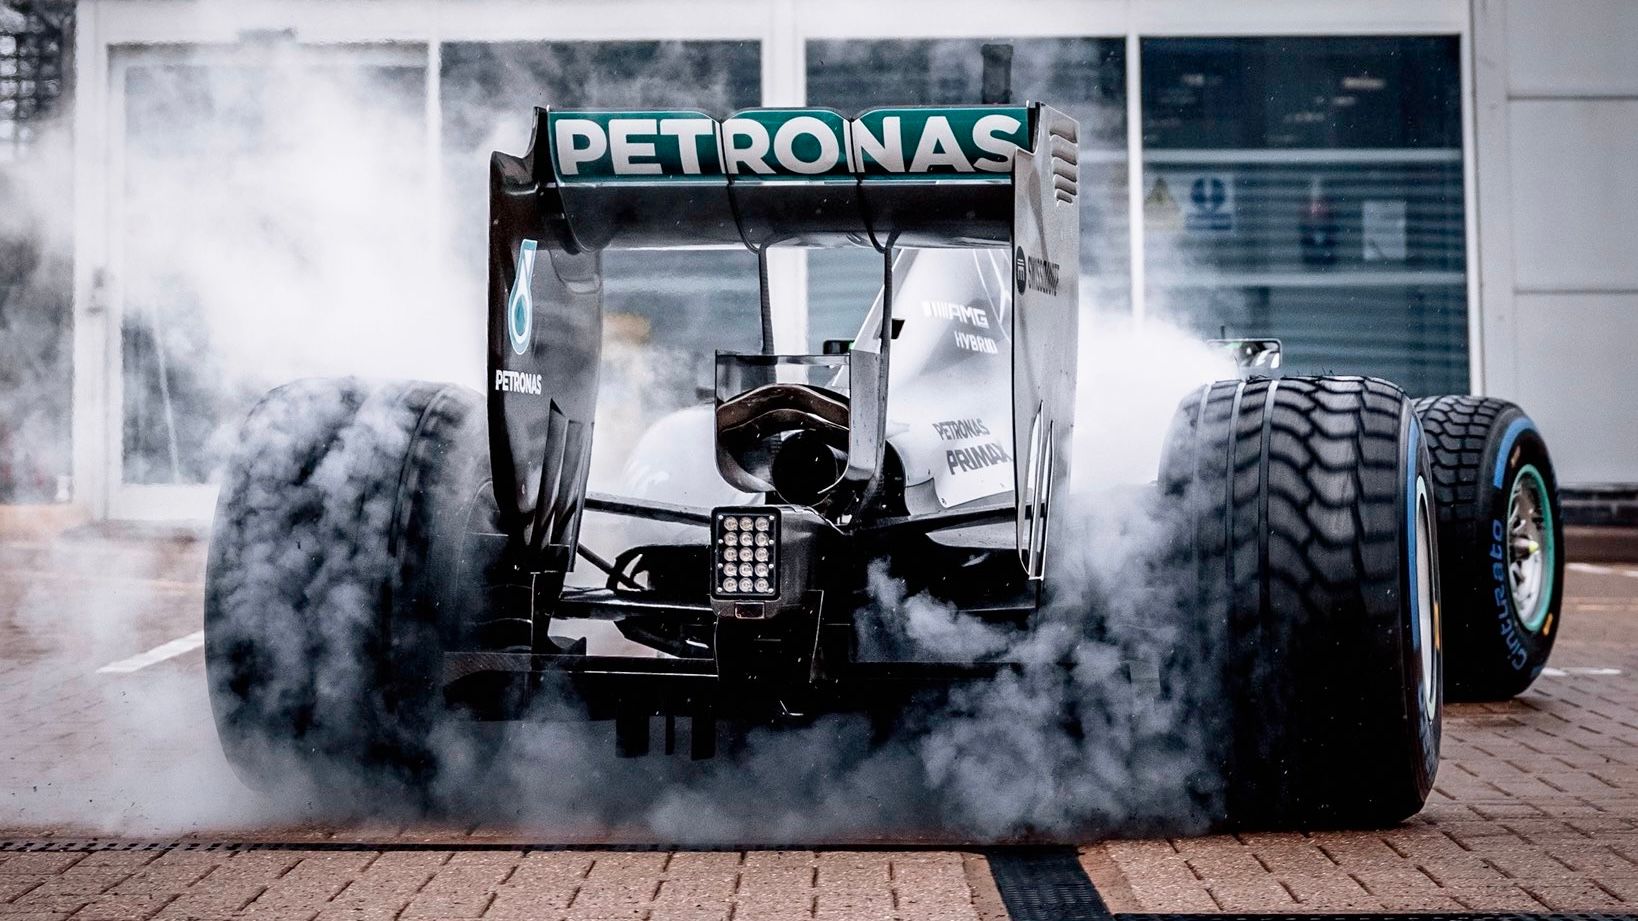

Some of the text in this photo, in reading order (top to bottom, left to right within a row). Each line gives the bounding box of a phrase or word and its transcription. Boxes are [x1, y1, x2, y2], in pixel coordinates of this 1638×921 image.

[554, 114, 1022, 175] PETRONAS
[954, 330, 998, 354] HYBRID
[495, 369, 542, 395] PETRONAS
[932, 418, 990, 440] PETRONAS
